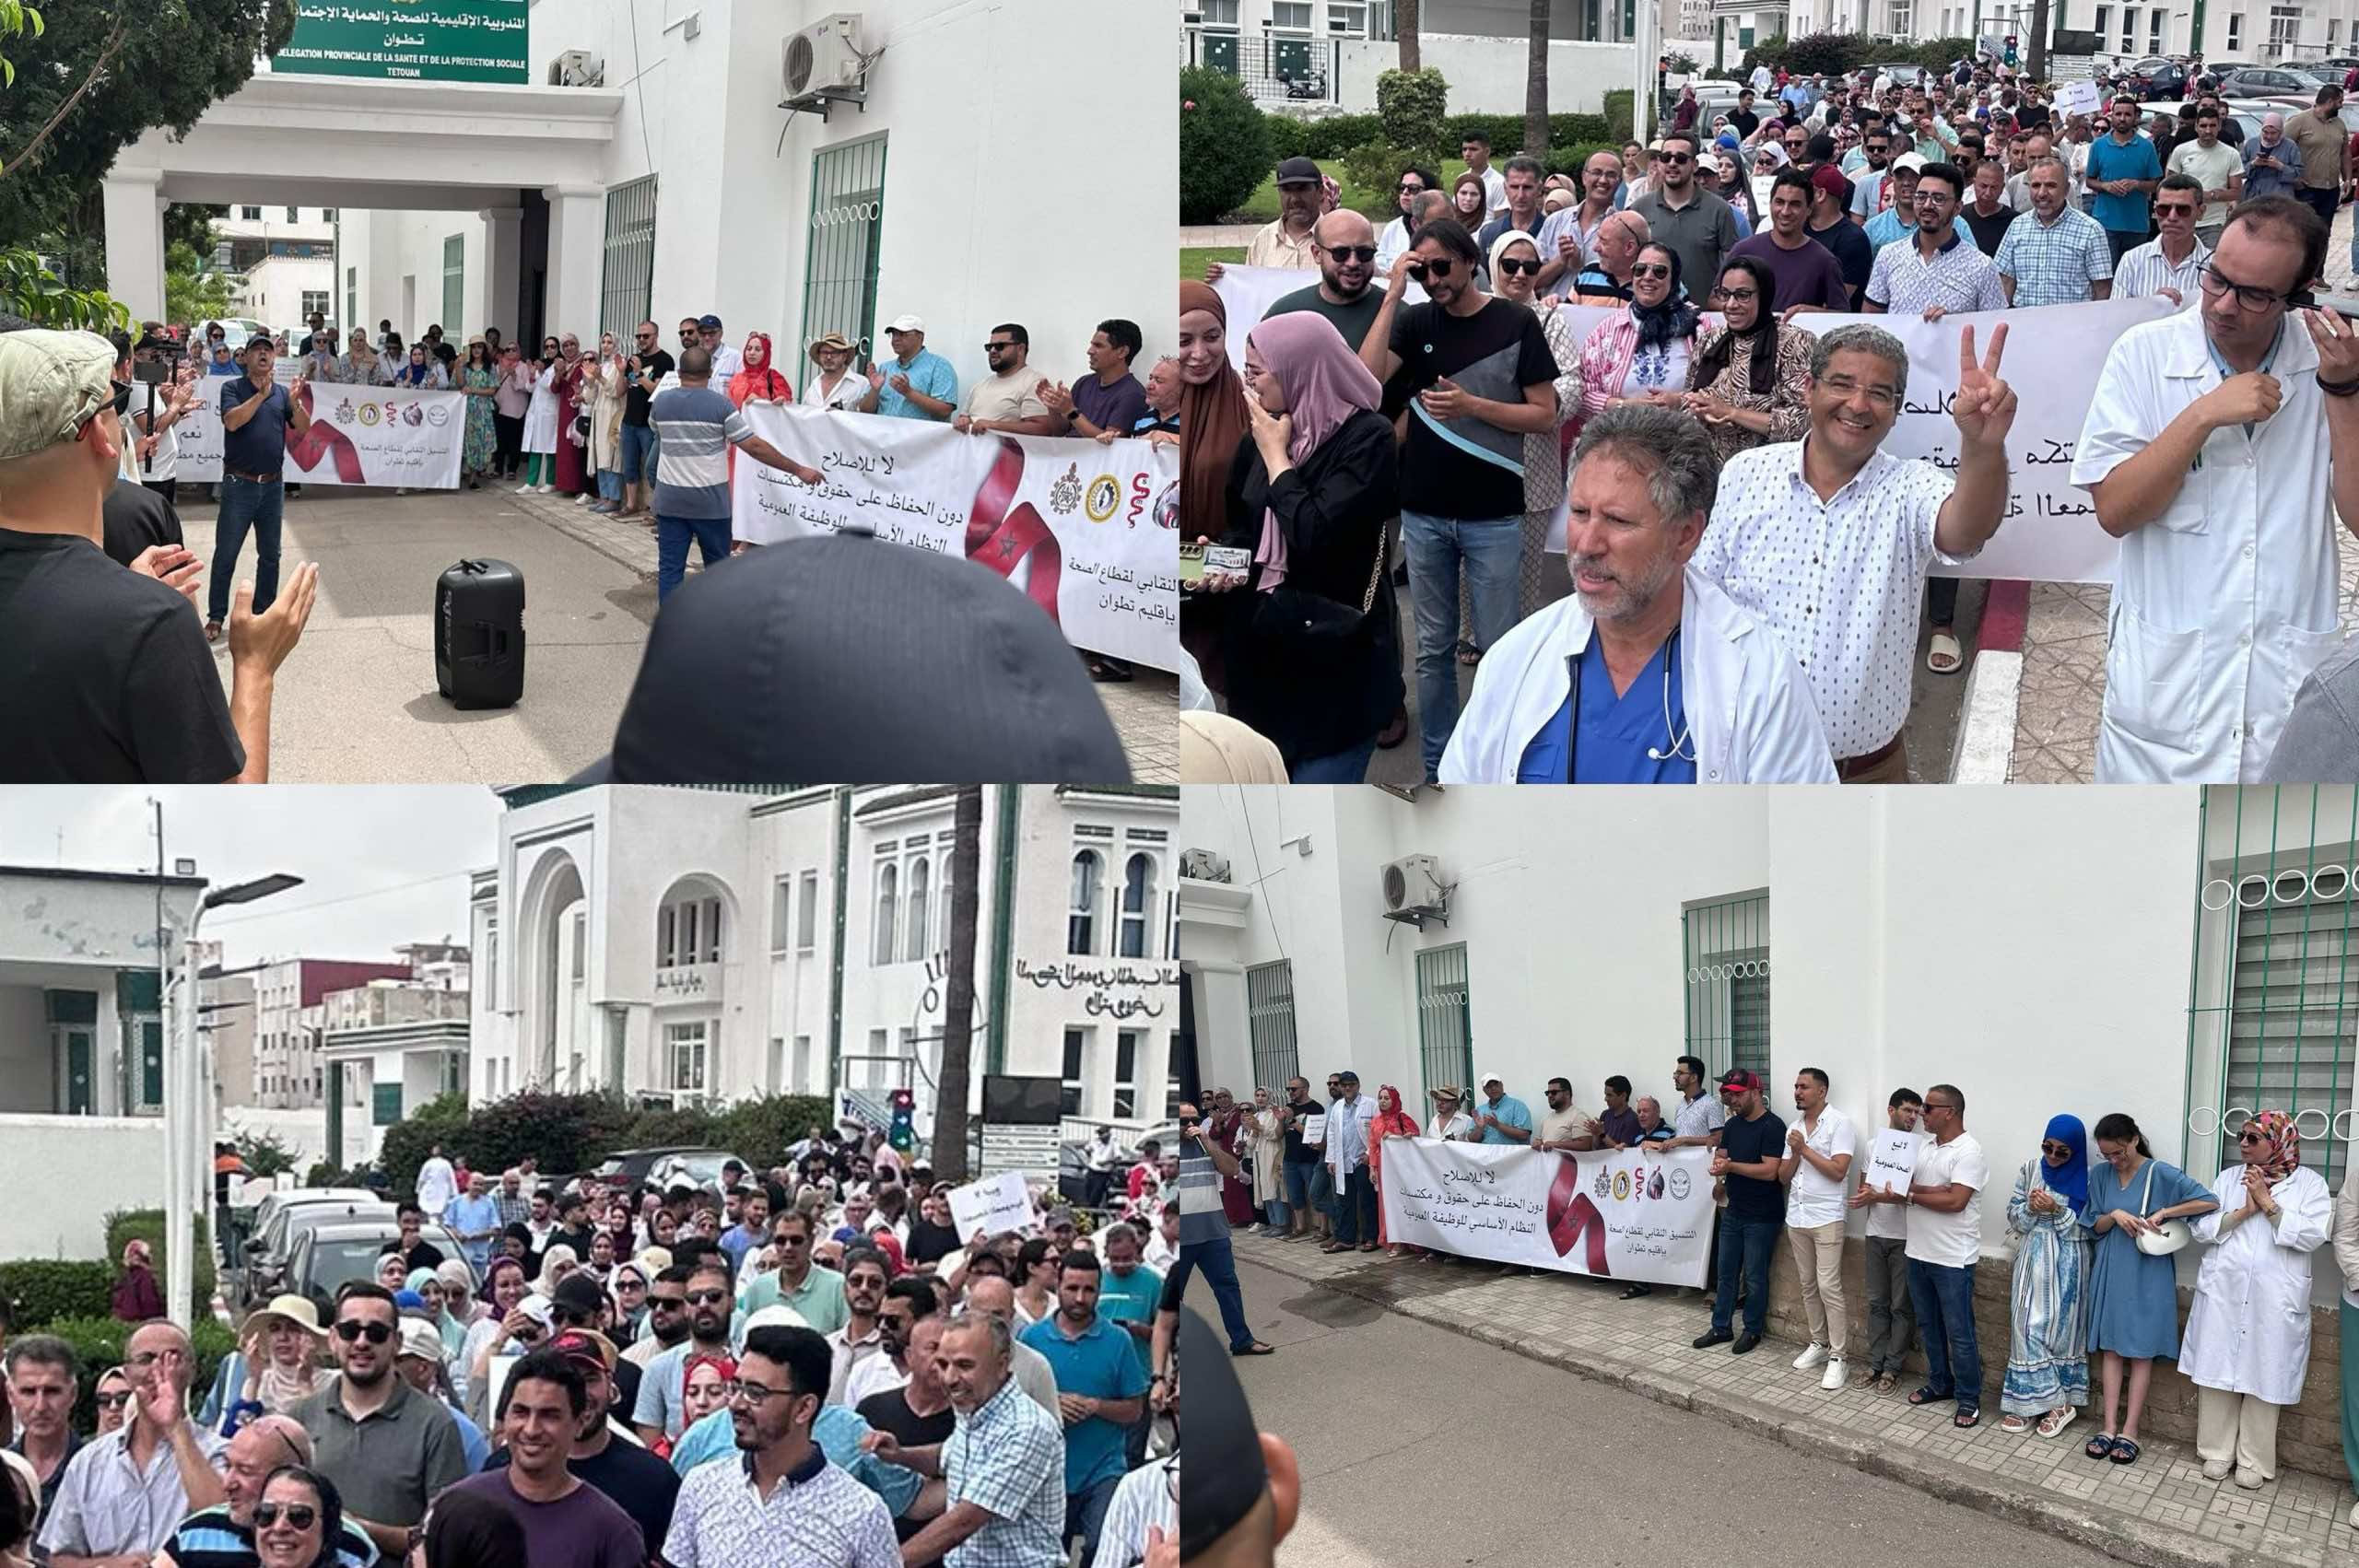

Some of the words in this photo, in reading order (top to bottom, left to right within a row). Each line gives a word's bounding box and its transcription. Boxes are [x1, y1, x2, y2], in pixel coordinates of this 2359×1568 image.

[296, 5, 339, 22] الإجتما
[341, 6, 390, 25] والحماية
[391, 10, 429, 24] للصحة
[431, 11, 480, 29] الإقليمية
[482, 15, 525, 31] المندوبية
[383, 32, 425, 47] تطوان
[323, 50, 371, 62] PROVINCIALE
[372, 53, 383, 62] DE
[383, 53, 393, 63] LA
[394, 53, 418, 64] SANTE
[419, 55, 429, 64] ET
[430, 56, 440, 65] DE
[440, 57, 451, 65] LA
[452, 57, 495, 67] PROTECTION
[496, 60, 525, 69] SOCIALE
[387, 67, 420, 77] TETOUAN
[821, 451, 875, 477] للإصلاح
[882, 452, 894, 475] لا
[817, 479, 852, 500] حقوق
[758, 493, 796, 518] العمومية
[856, 489, 882, 508] على
[886, 493, 934, 517] الحفاظ
[938, 506, 964, 527] دون
[1069, 556, 1099, 576] الصحة
[1098, 568, 1133, 585] لقطاع
[1099, 592, 1135, 613] تطوان
[1138, 603, 1176, 626] بإقليم
[1903, 1141, 1908, 1150] لا
[1442, 1169, 1483, 1186] للإصلاح
[1485, 1170, 1496, 1185] لا
[1436, 1196, 1441, 1204] و
[1444, 1191, 1470, 1205] حقوق
[1472, 1194, 1490, 1209] على
[1493, 1195, 1525, 1210] الحفاظ
[1527, 1202, 1543, 1215] دون
[1432, 1211, 1467, 1229] للوظيفة
[1469, 1215, 1508, 1233] الأساسي
[1508, 1223, 1536, 1236] النظام
[1669, 1230, 1696, 1241] التنسيق
